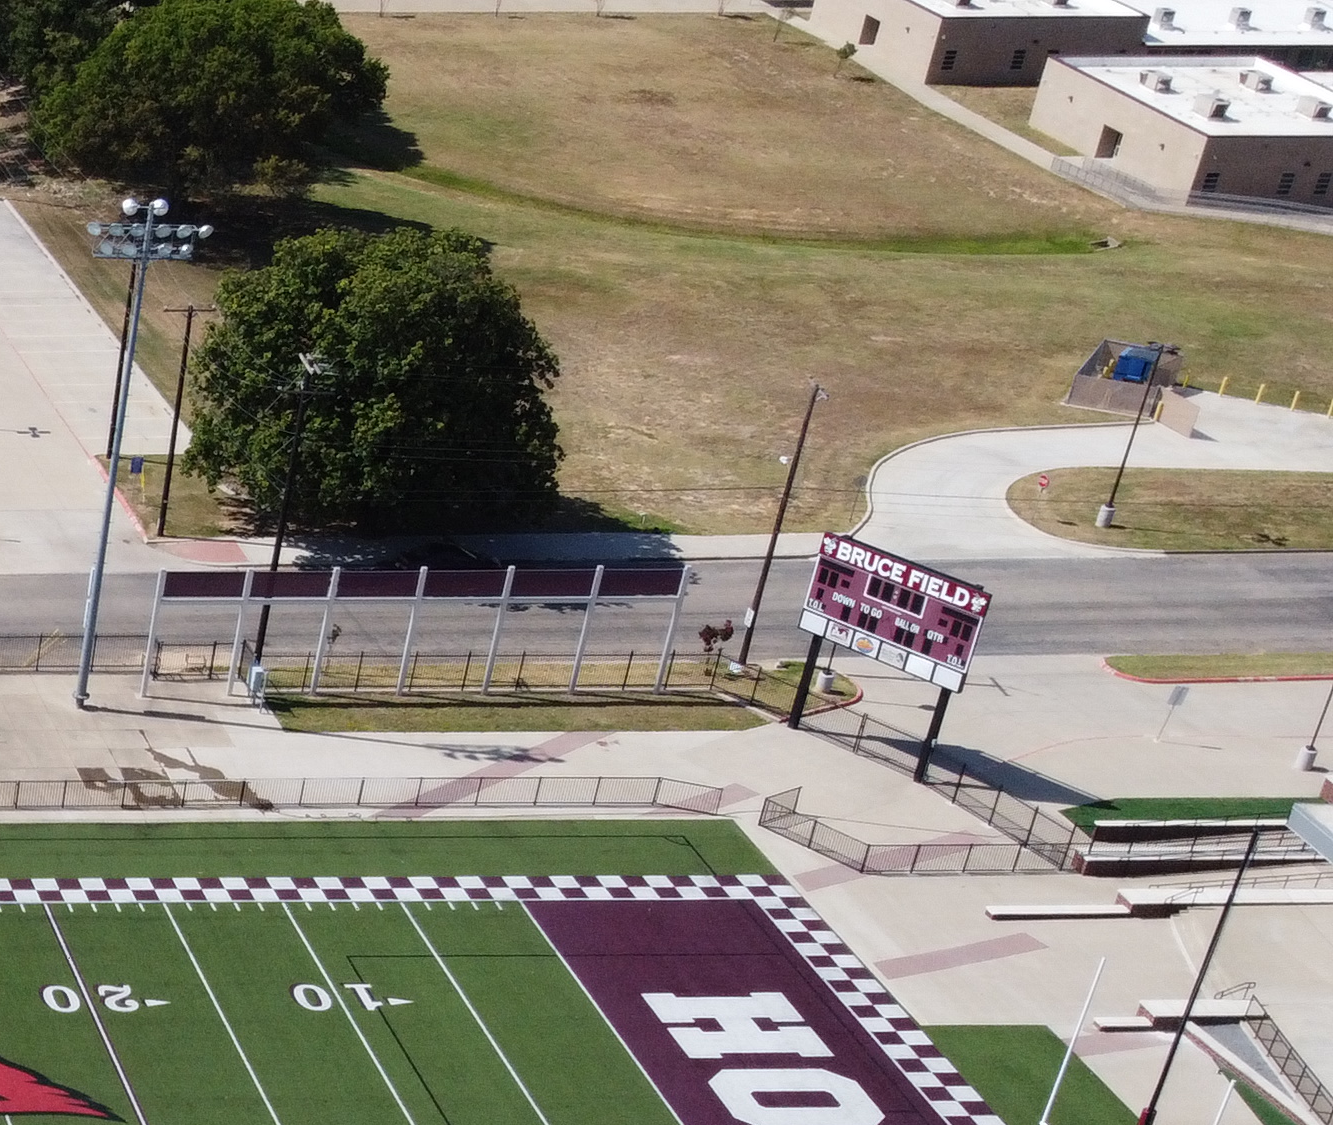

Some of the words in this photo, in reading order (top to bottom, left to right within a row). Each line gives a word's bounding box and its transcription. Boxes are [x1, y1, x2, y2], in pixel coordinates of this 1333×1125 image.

[836, 541, 906, 581] BRUCE
[907, 569, 970, 609] FIELD
[832, 592, 856, 608] DOWN
[860, 603, 870, 614] TO
[871, 608, 882, 619] GO
[894, 617, 909, 631] BALL
[927, 630, 944, 643] QTR
[41, 983, 141, 1012] 20
[291, 982, 385, 1011] 10
